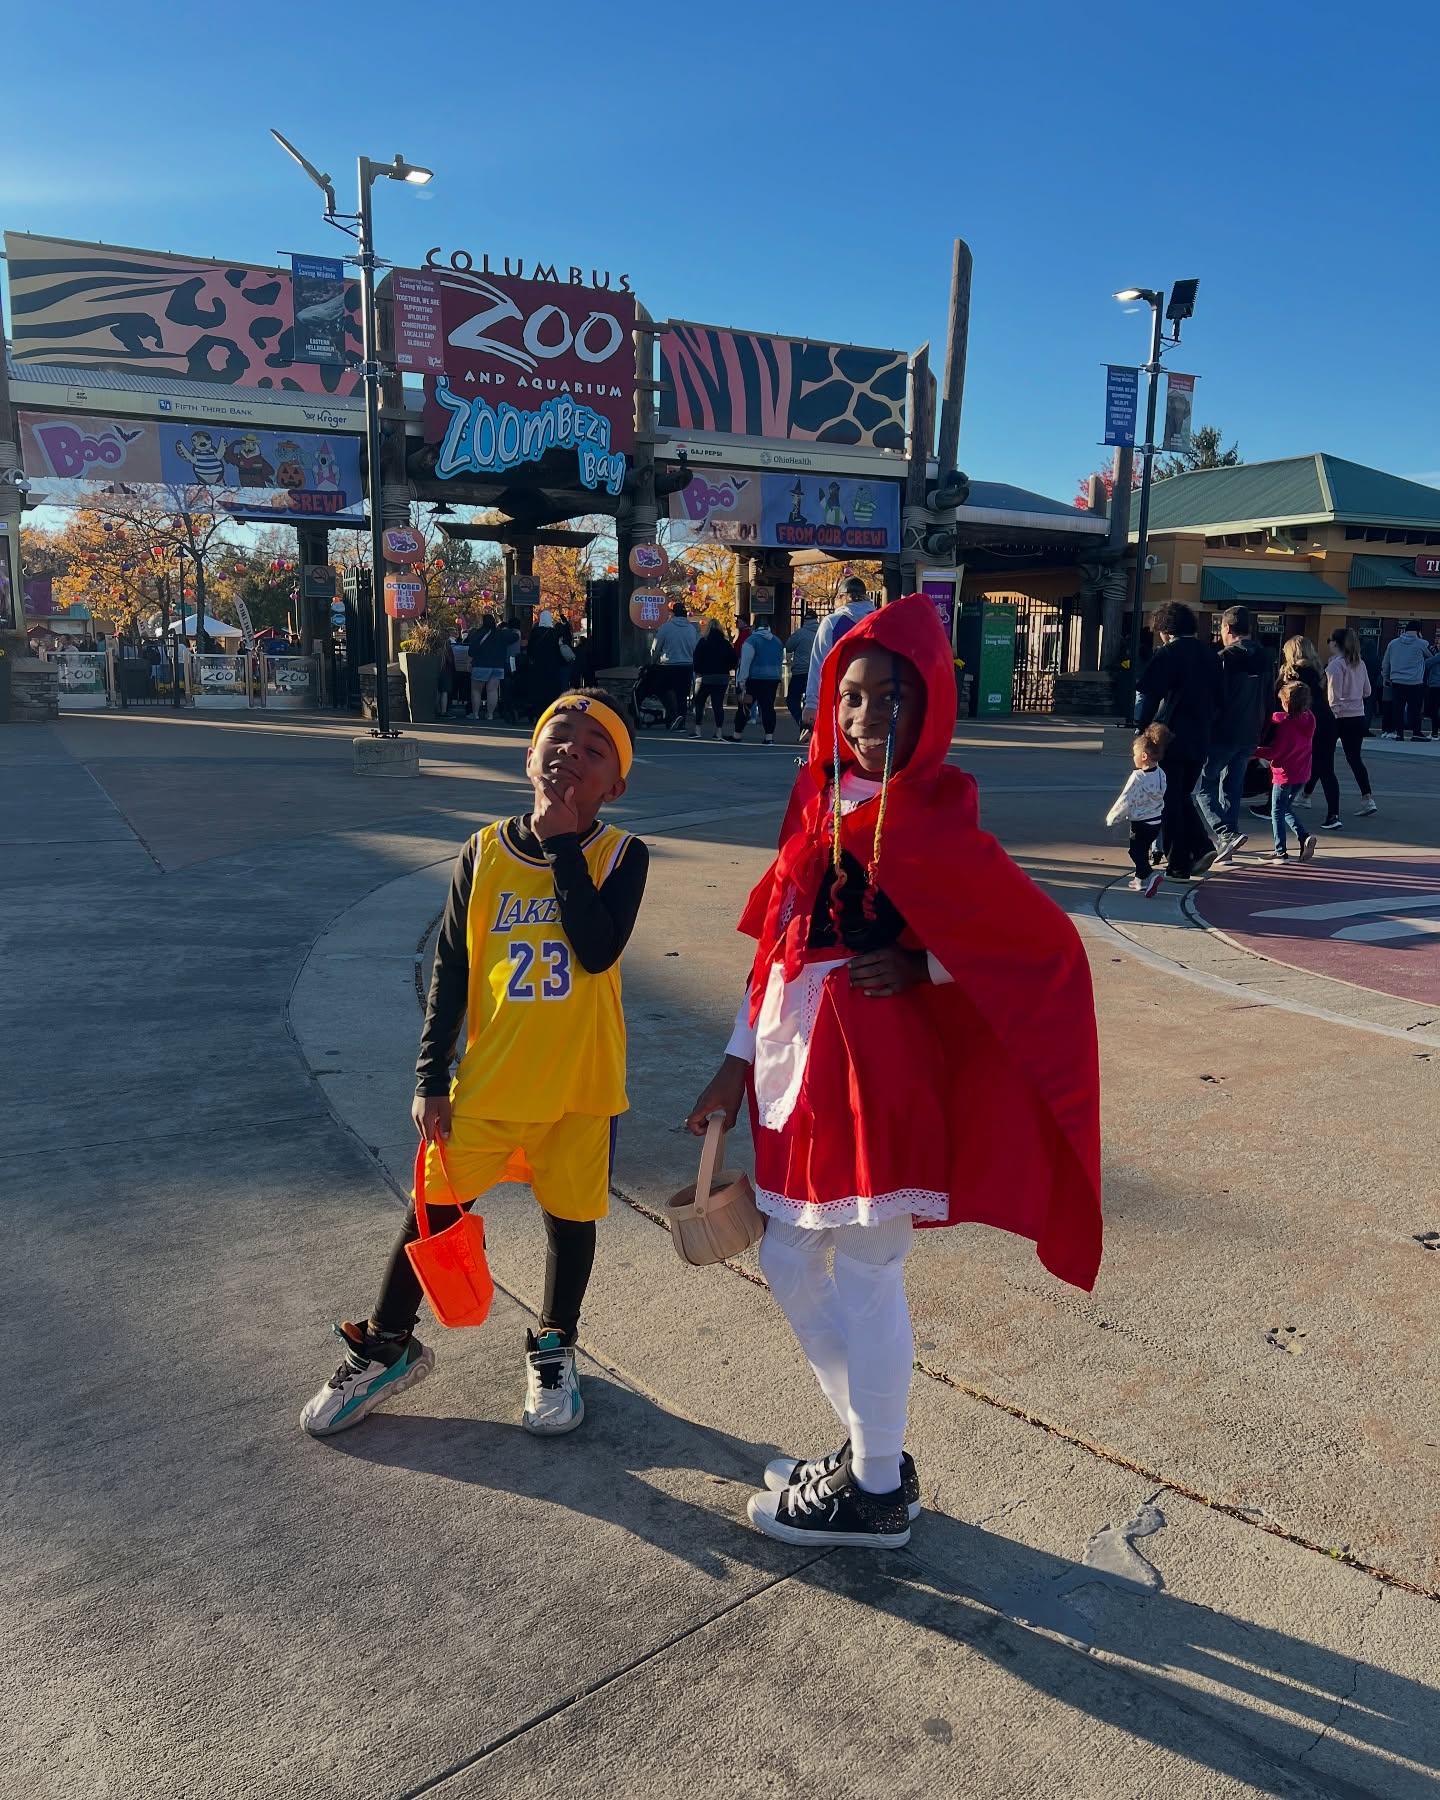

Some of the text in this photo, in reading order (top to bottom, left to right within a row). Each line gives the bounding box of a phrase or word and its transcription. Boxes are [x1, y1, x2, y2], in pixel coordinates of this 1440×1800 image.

[426, 247, 630, 292] COLUMBUS
[431, 268, 624, 374] ZOO
[464, 370, 622, 398] AND AQUARIUM
[175, 403, 253, 416] FIFTH THIRD BANK
[318, 410, 347, 428] Kroger
[34, 422, 125, 478] Boo
[773, 456, 812, 466] OhioHealth
[681, 474, 738, 521] Boo
[778, 526, 888, 546] FROM OUR CREW!
[202, 670, 234, 682] ZOO
[278, 670, 308, 683] ZOO
[490, 892, 562, 933] LAKE
[508, 940, 572, 1001] 23
